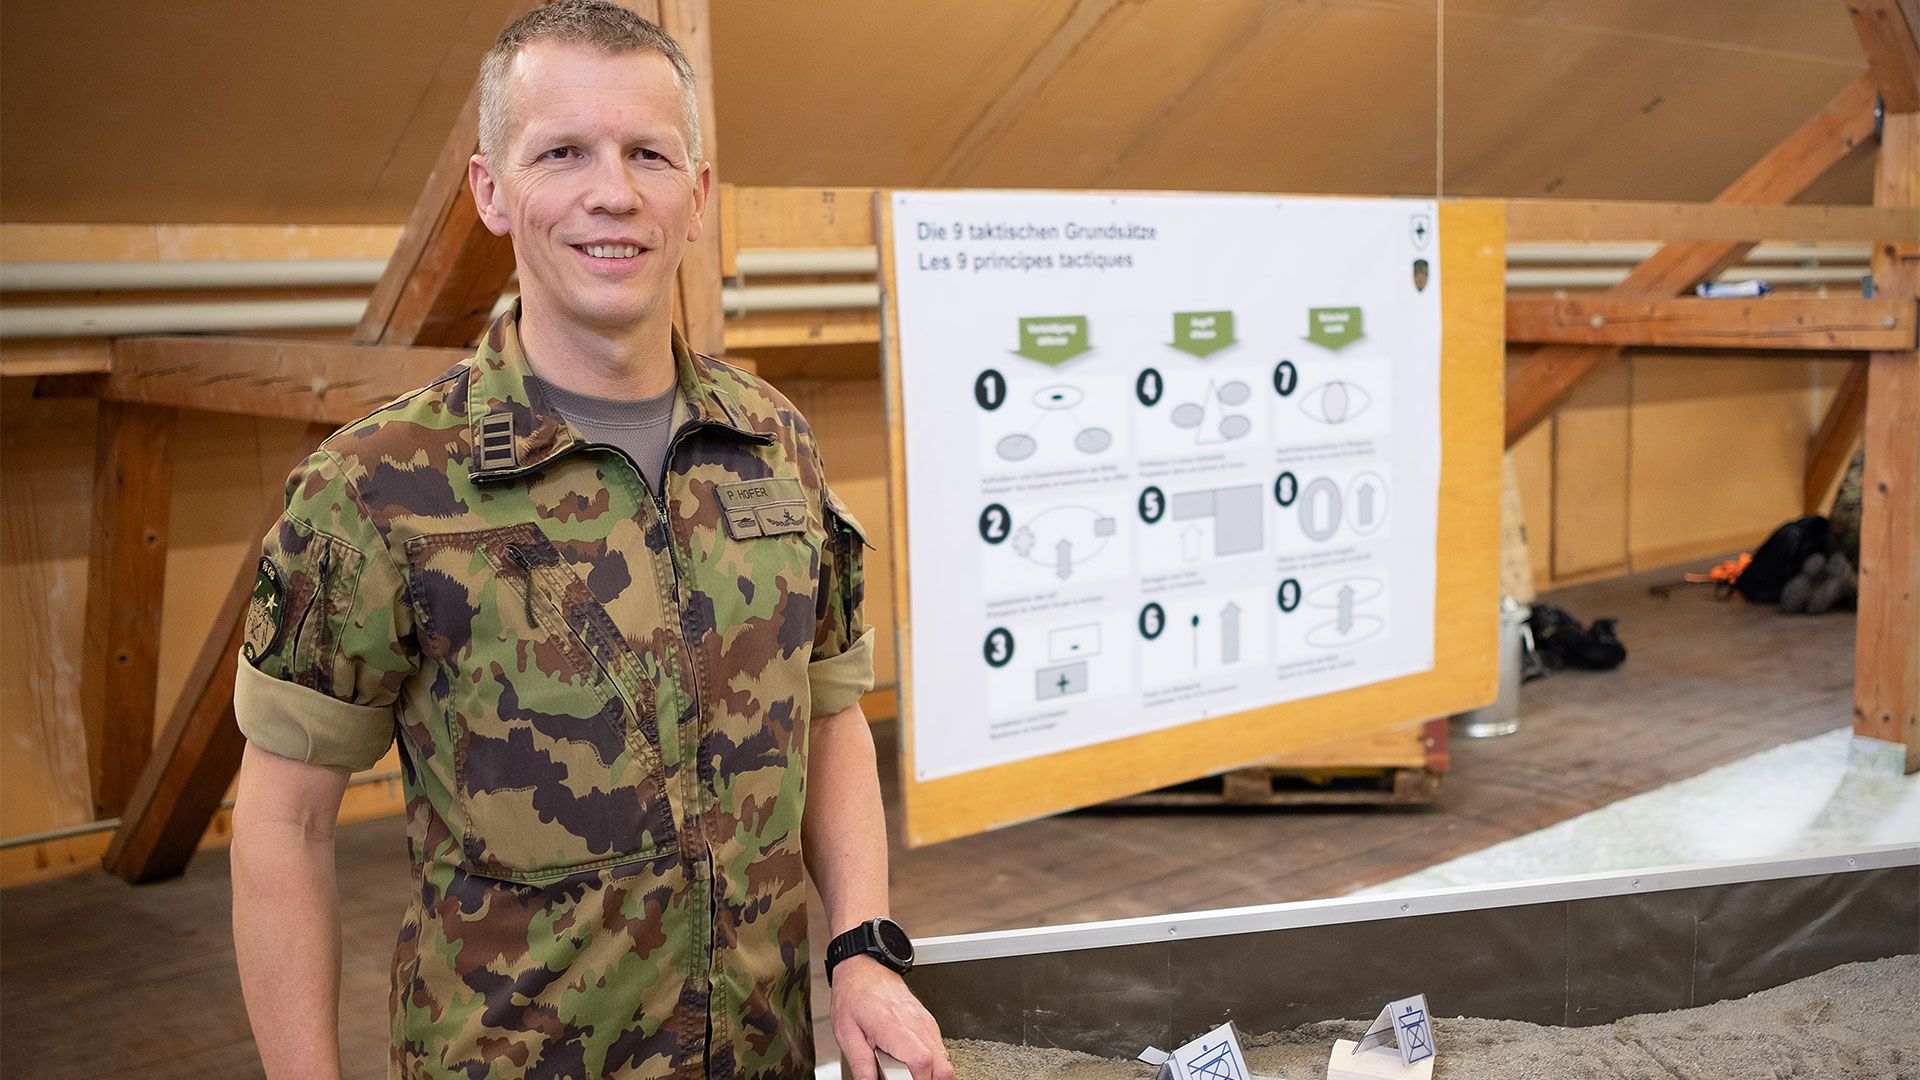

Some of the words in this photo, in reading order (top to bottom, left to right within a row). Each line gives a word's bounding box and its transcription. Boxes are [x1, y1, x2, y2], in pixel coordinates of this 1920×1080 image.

[917, 222, 946, 240] Die
[953, 222, 964, 240] 9
[969, 222, 1059, 240] taktischen
[1064, 222, 1156, 240] Grundsätze
[918, 252, 950, 270] Les
[957, 251, 967, 270] 9
[973, 252, 1053, 273] principes
[1060, 252, 1133, 273] tactiques
[738, 487, 768, 500] HOFER
